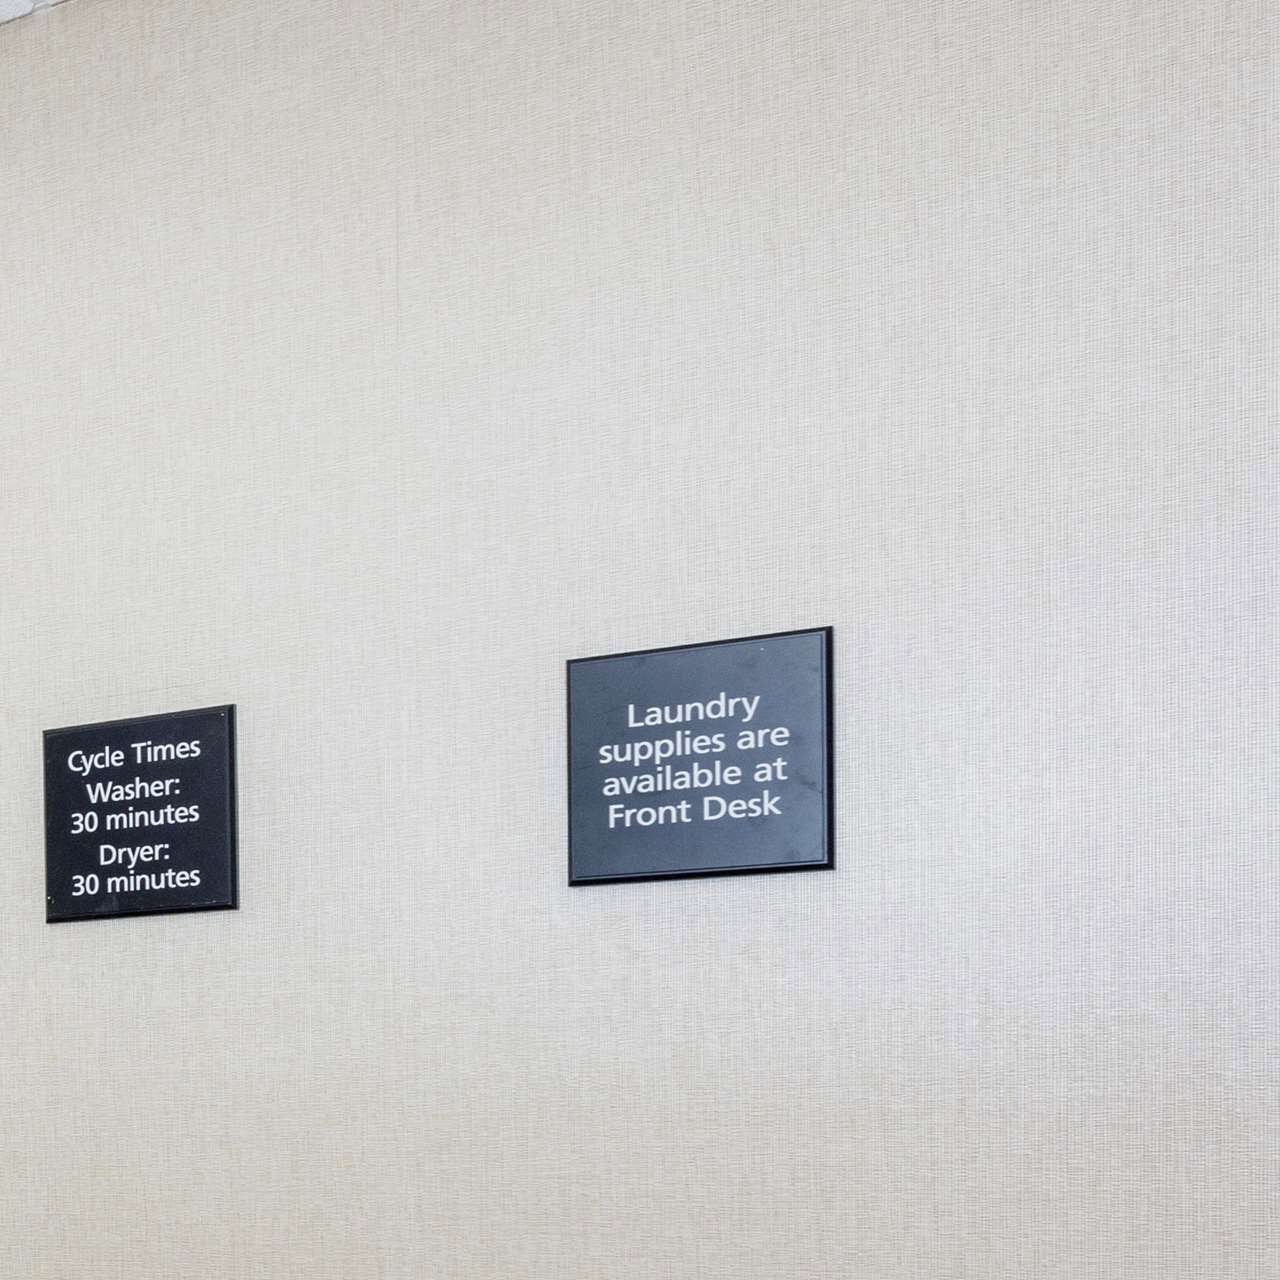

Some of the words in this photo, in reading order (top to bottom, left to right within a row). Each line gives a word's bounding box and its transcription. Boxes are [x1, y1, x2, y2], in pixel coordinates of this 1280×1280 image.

[628, 692, 760, 728] Laundry
[67, 746, 125, 777] Cycle
[131, 740, 201, 764] Times
[599, 730, 726, 767] supplies
[736, 726, 790, 750] are
[86, 777, 180, 804] Washer:
[602, 760, 741, 797] available
[753, 757, 788, 783] at
[71, 811, 98, 834] 30
[106, 804, 200, 830] minutes
[608, 800, 692, 828] Front
[703, 790, 782, 821] Desk
[99, 843, 170, 869] Dryer:
[71, 874, 99, 896] 30
[107, 868, 200, 893] minutes
